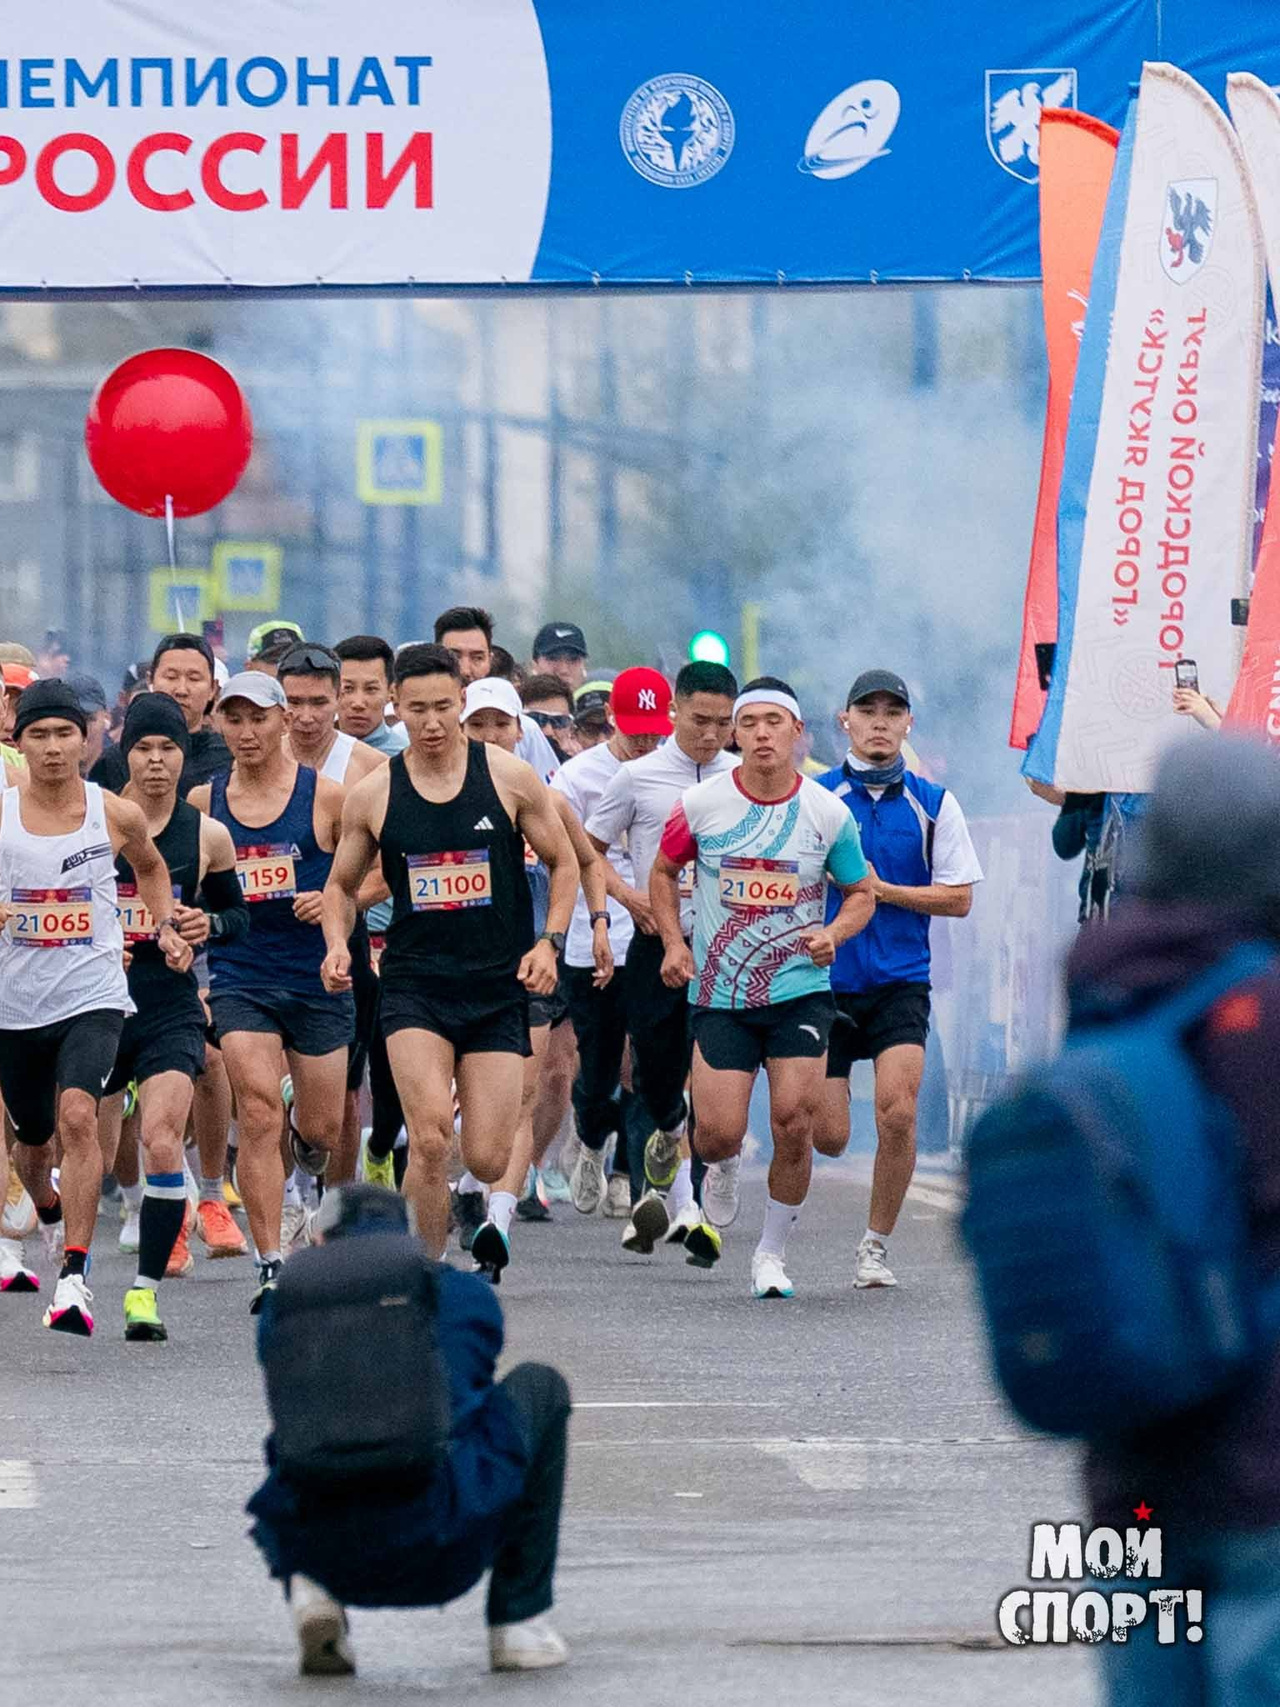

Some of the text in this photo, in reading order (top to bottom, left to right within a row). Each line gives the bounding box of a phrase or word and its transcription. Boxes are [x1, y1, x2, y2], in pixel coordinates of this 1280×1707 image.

[637, 688, 657, 710] NY
[238, 866, 289, 889] 1159
[416, 873, 486, 897] 21100
[722, 878, 795, 901] 21064
[16, 913, 90, 933] 21065
